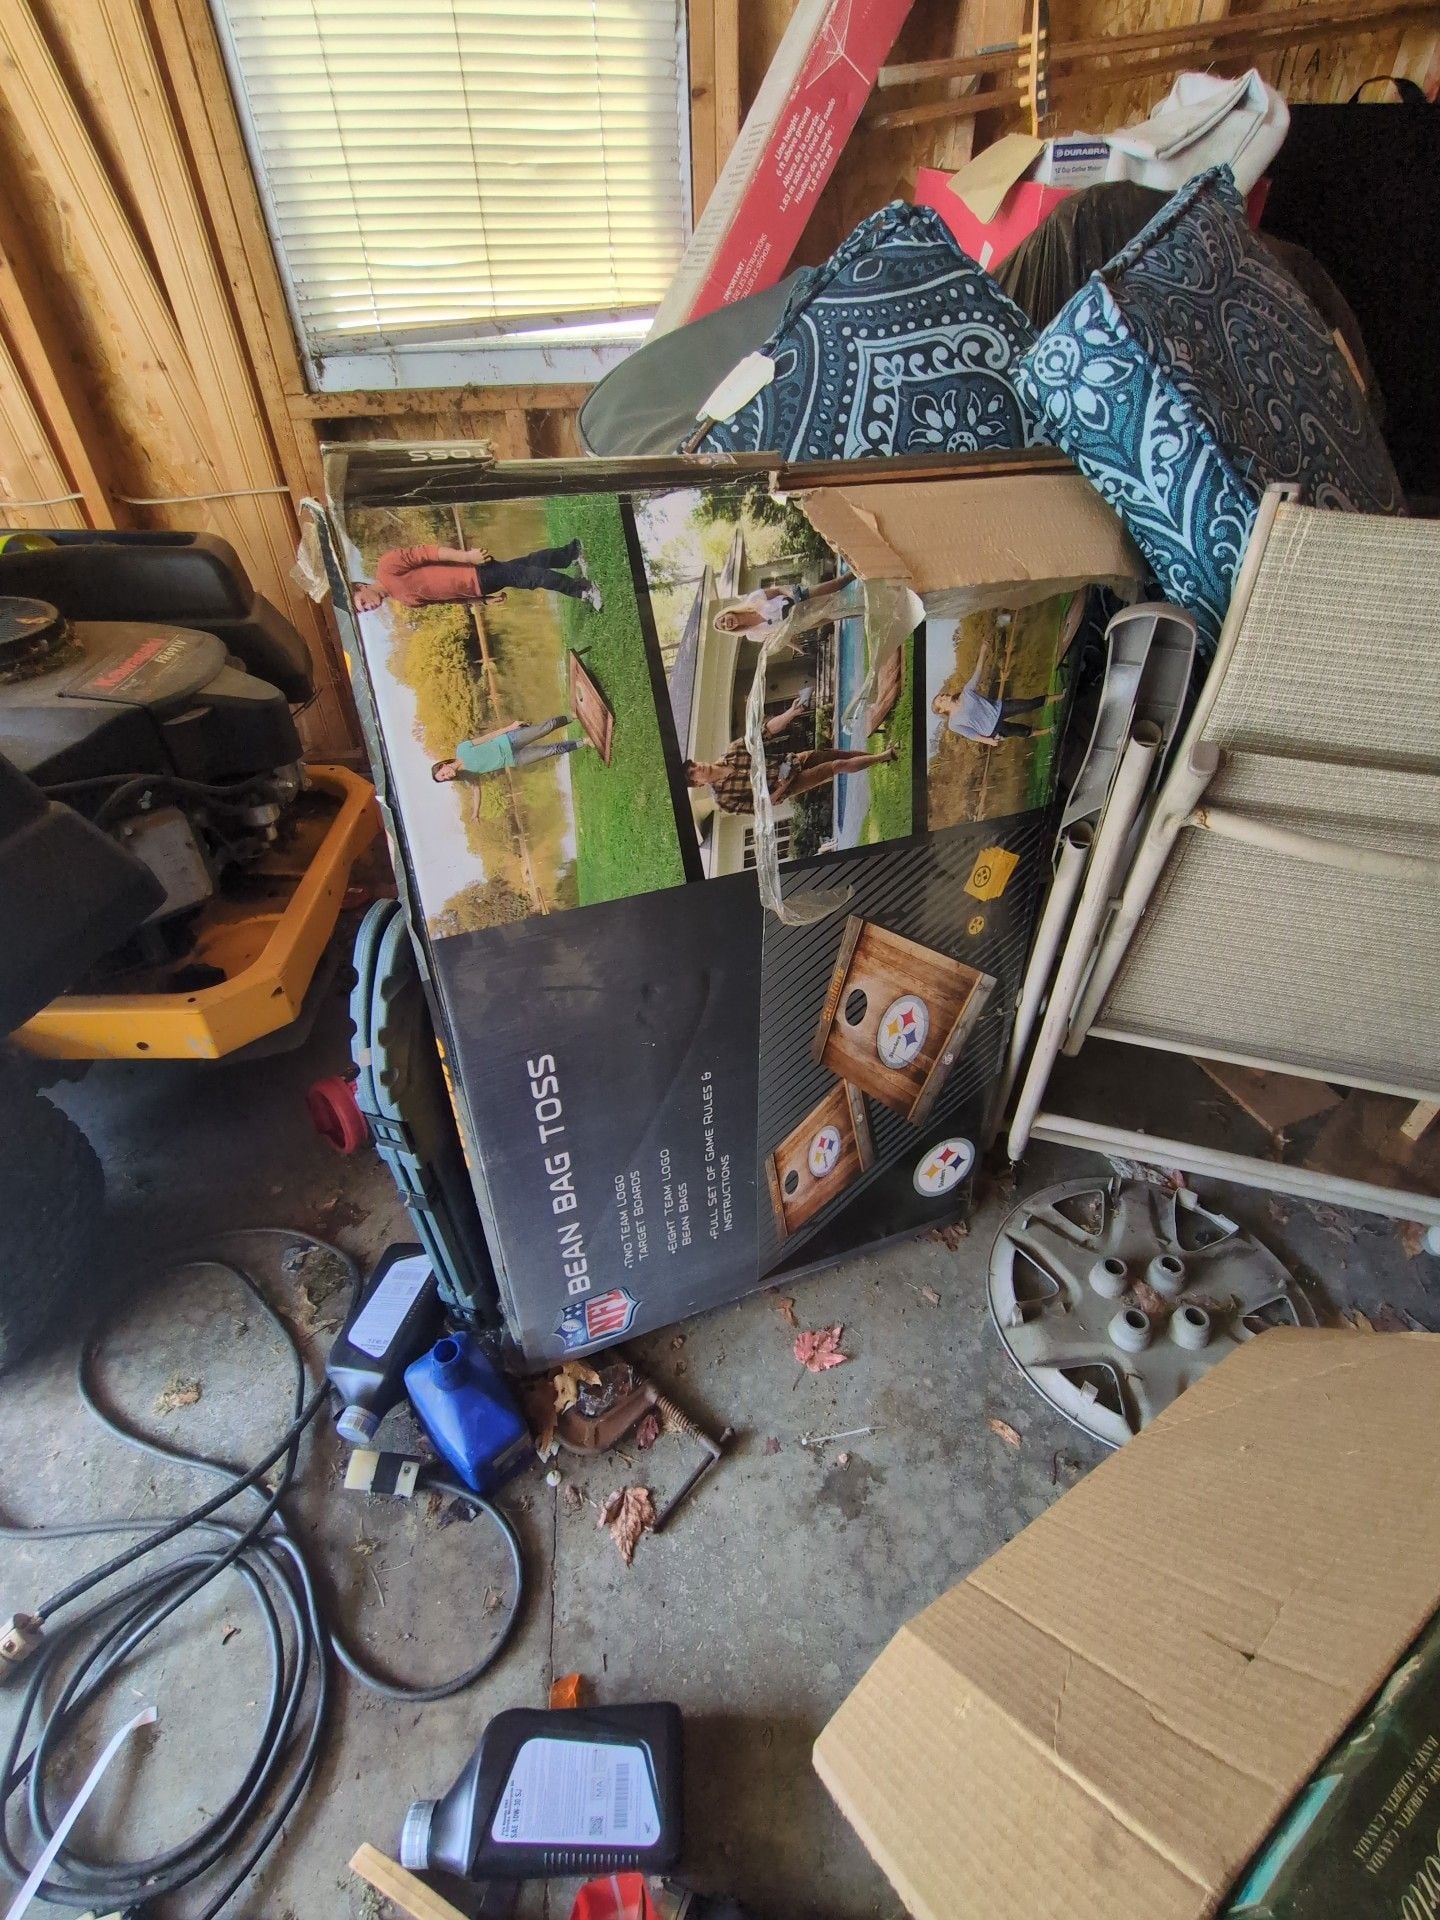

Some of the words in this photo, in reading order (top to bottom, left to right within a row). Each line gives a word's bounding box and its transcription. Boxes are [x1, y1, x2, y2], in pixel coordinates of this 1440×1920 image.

[775, 141, 787, 160] Line
[776, 168, 782, 177] 6
[779, 161, 786, 170] ft
[784, 136, 798, 163] above
[795, 106, 812, 138] ground
[779, 194, 791, 213] 1.83
[787, 185, 796, 195] m
[793, 163, 806, 187] sobre
[803, 153, 811, 164] el
[808, 133, 820, 155] nivel
[817, 119, 826, 135] del
[823, 97, 836, 121] suelo
[815, 169, 822, 179] m
[820, 158, 828, 172] du
[825, 144, 834, 159] sol
[783, 162, 797, 189] Altura
[794, 151, 802, 164] de
[799, 143, 806, 153] la
[793, 172, 812, 204] Hauteur
[810, 160, 818, 173] de
[815, 151, 822, 162] la
[820, 128, 833, 153] corde
[743, 232, 768, 278] INSTRUCTIONS
[408, 448, 493, 462] TOSS
[701, 1071, 713, 1082] &
[526, 1053, 566, 1145] TOSS
[702, 1084, 714, 1126] RULES
[659, 1148, 672, 1182] LOGO
[704, 1127, 716, 1163] GAME
[544, 1151, 578, 1215] BAG
[614, 1174, 627, 1207] LOGO
[629, 1169, 645, 1217] BOARDS
[663, 1185, 675, 1217] TEAM
[678, 1181, 690, 1213] BAGS
[707, 1185, 718, 1208] SET
[721, 1153, 733, 1232] INSTRUCTIONS
[620, 1211, 631, 1242] TEAM
[633, 1219, 649, 1262] TARGET
[682, 1215, 692, 1247] BEAN
[557, 1221, 592, 1296] BEAN
[588, 1291, 627, 1336] NFL
